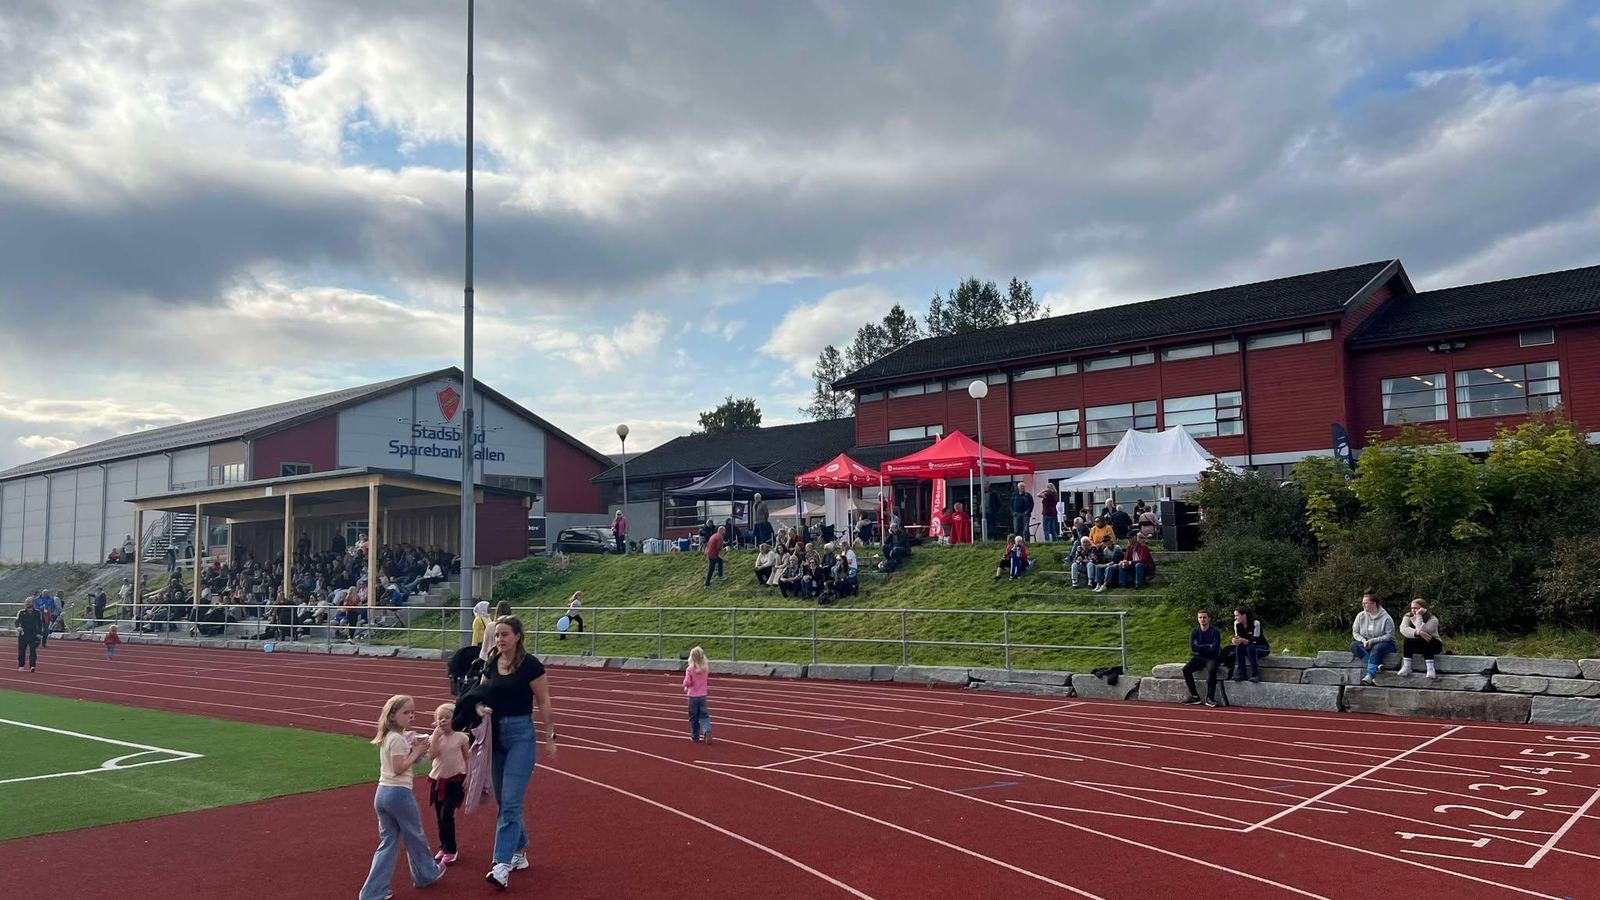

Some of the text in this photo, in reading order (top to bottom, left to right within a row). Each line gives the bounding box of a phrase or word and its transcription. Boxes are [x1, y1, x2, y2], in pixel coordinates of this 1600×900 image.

[412, 424, 485, 445] Stadsbd
[389, 440, 505, 461] Sparebankallen
[1544, 735, 1600, 743] 6
[1519, 748, 1591, 760] 5
[1499, 765, 1573, 775] 4
[1468, 783, 1548, 796] 3
[1433, 804, 1525, 820] 2
[1393, 830, 1492, 848] 1
